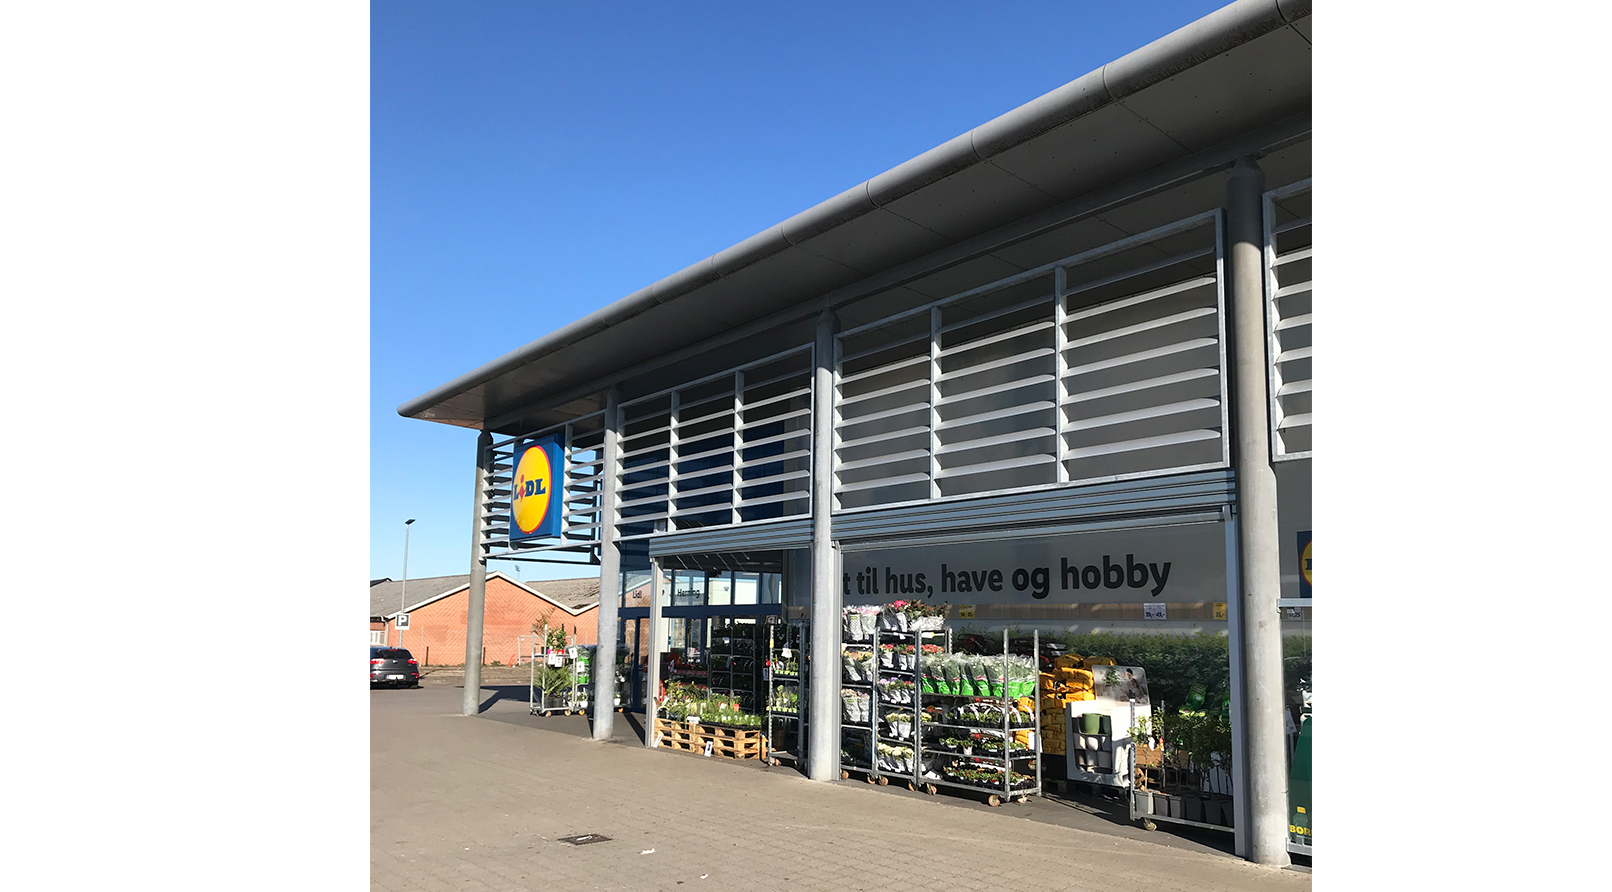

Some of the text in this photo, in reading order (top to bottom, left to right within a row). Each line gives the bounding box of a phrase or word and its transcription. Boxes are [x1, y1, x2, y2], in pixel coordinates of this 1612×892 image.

[856, 566, 879, 595] til
[885, 567, 934, 599] hus,
[941, 563, 1003, 593] have
[1012, 567, 1050, 600] og
[1060, 554, 1172, 598] hobby
[398, 615, 408, 627] P
